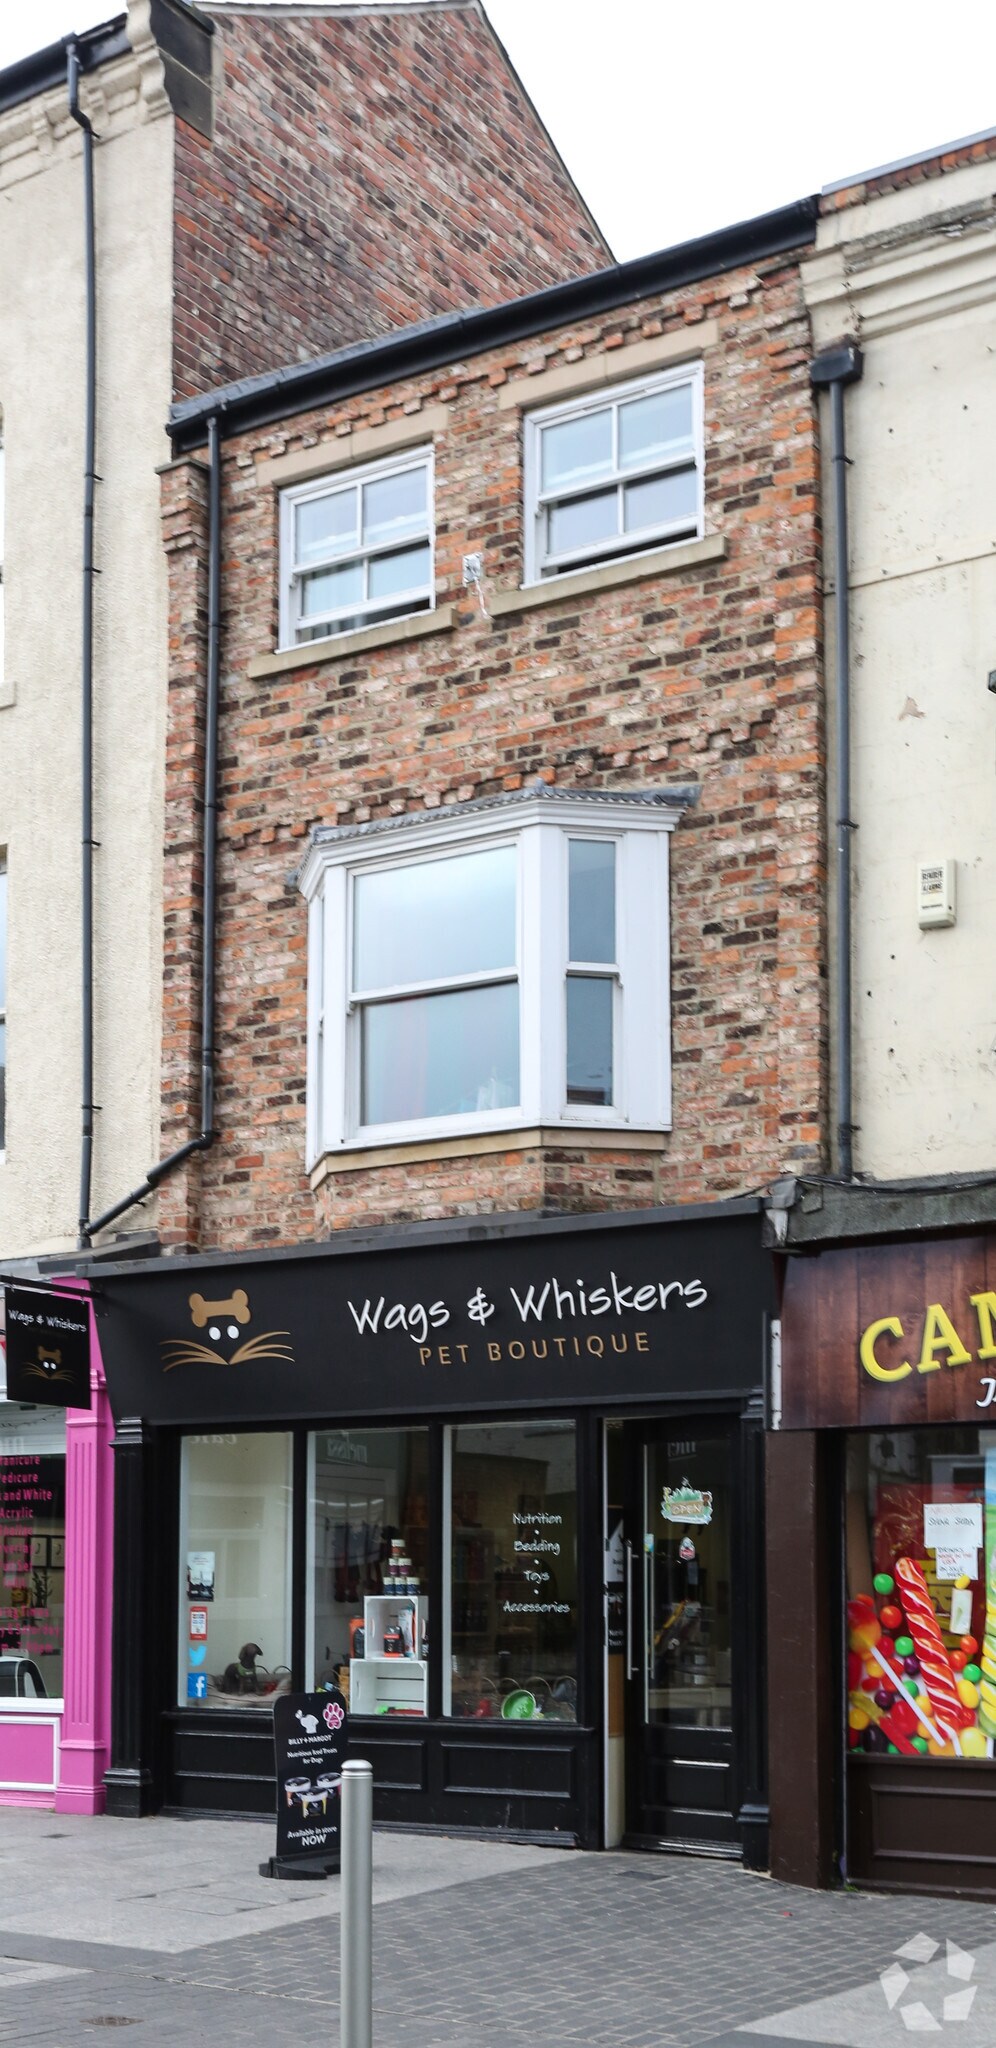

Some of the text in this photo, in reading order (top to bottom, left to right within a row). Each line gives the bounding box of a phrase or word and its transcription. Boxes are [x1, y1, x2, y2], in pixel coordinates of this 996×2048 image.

[347, 1271, 708, 1344] Wags & Whiskers
[8, 1309, 87, 1332] Wags & Whiskers
[418, 1332, 650, 1366] PET BOUTIQUE
[0, 1472, 38, 1483] edicure
[23, 1488, 53, 1501] White
[512, 1512, 562, 1525] Nutrition
[514, 1540, 560, 1556] Bedding
[523, 1570, 550, 1584] Toys
[503, 1600, 570, 1613] Accessories
[287, 1826, 338, 1839] Available in store
[301, 1834, 327, 1846] NOW
